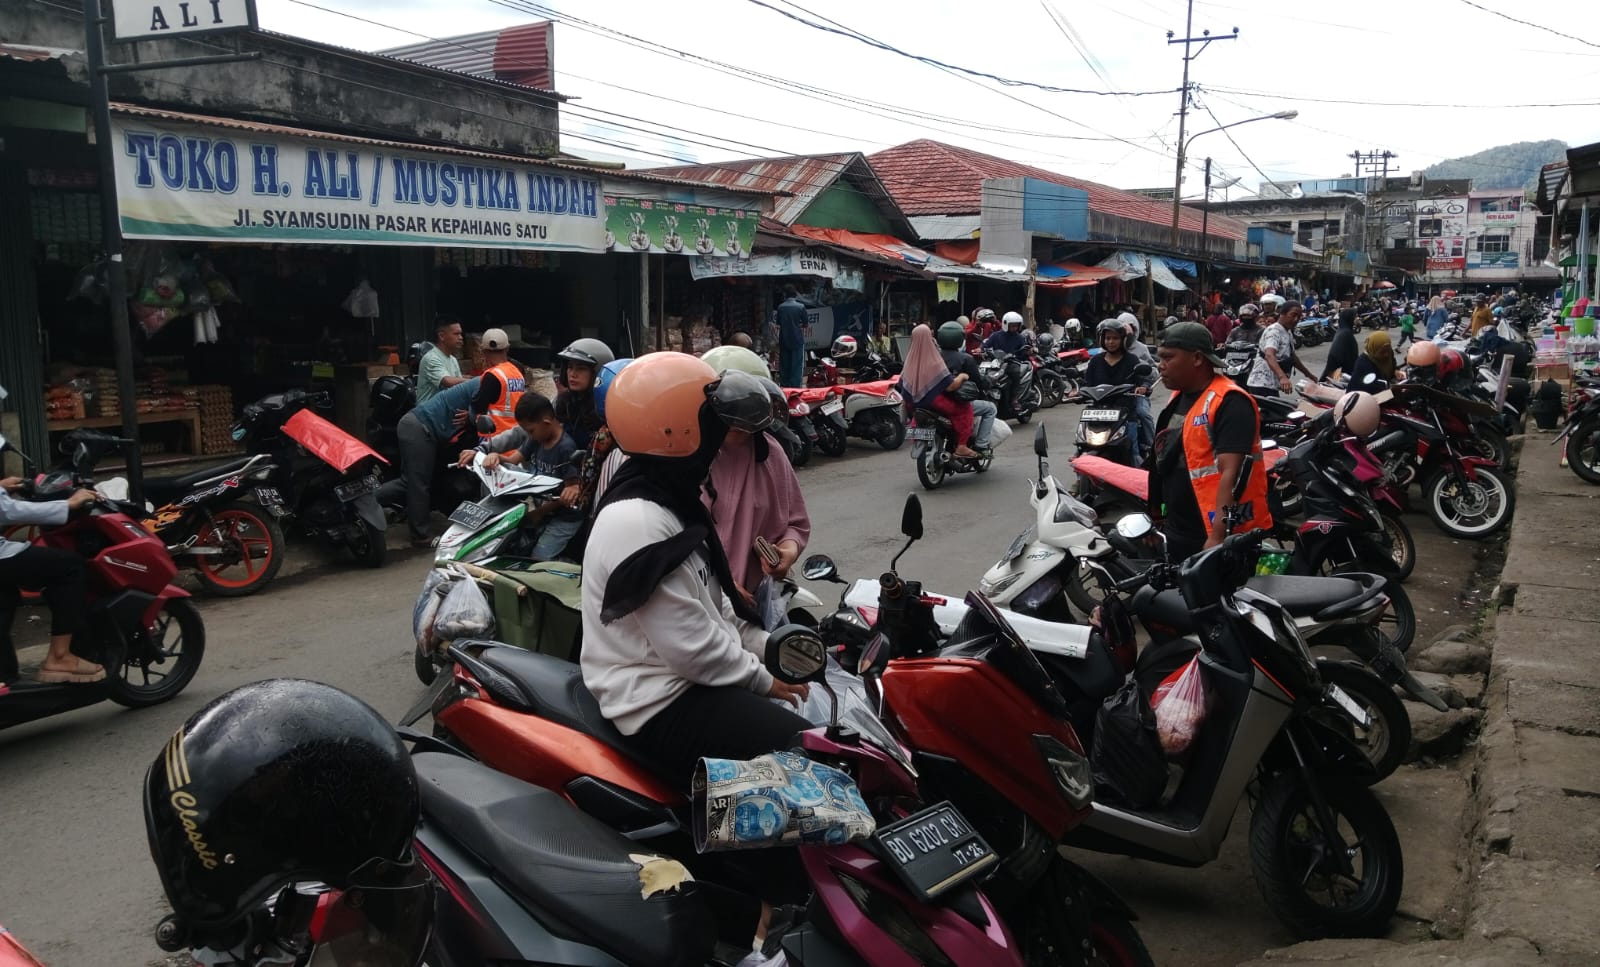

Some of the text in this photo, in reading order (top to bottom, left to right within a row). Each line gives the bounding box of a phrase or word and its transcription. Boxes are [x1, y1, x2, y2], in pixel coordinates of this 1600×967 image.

[151, 0, 223, 31] ALI
[125, 129, 239, 194] TOKO
[250, 143, 291, 197] H.
[303, 148, 362, 200] ALI
[391, 156, 521, 212] MUSTIKA
[526, 171, 598, 218] INDAH
[263, 209, 370, 231] SYAMSUDIN
[376, 214, 427, 233] PASAR
[431, 217, 511, 237] KEPAHIANG
[516, 223, 547, 240] SATU
[800, 260, 828, 272] ERNA
[171, 791, 218, 870] Classic
[886, 836, 915, 864] BD
[909, 823, 949, 853] 6202
